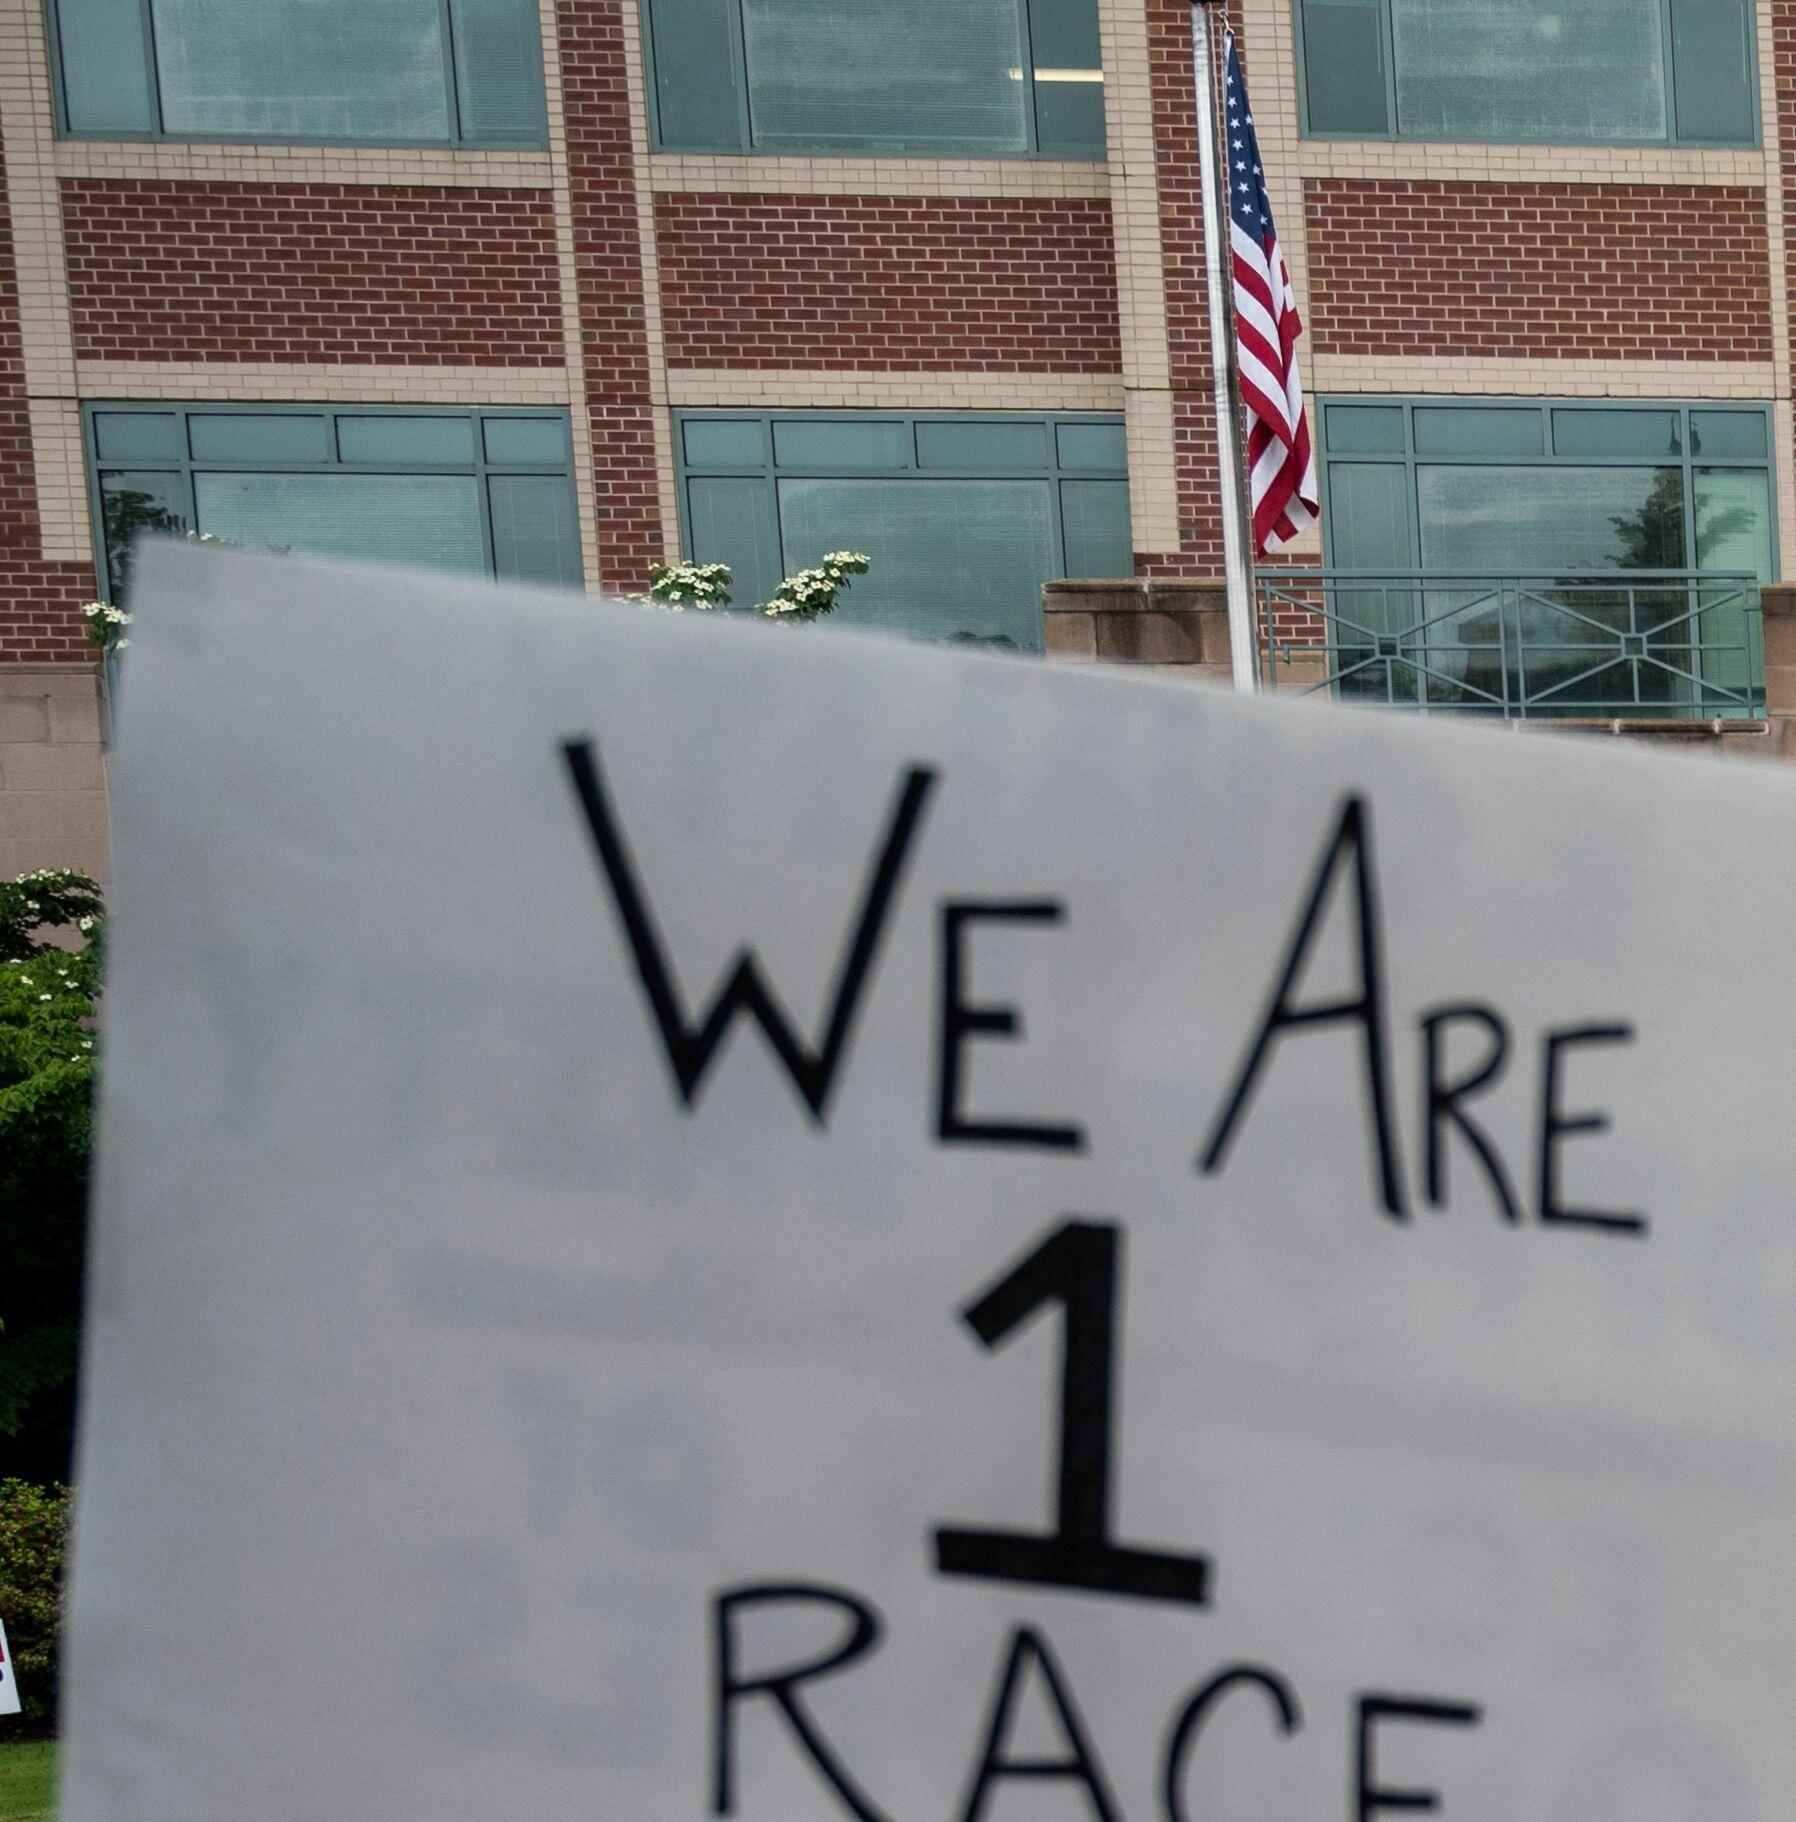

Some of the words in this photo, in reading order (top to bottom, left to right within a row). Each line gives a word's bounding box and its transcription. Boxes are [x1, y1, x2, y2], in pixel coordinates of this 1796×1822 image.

[555, 733, 1091, 1158] WE
[1195, 789, 1649, 1238] ARE
[928, 1216, 1213, 1610] 1
